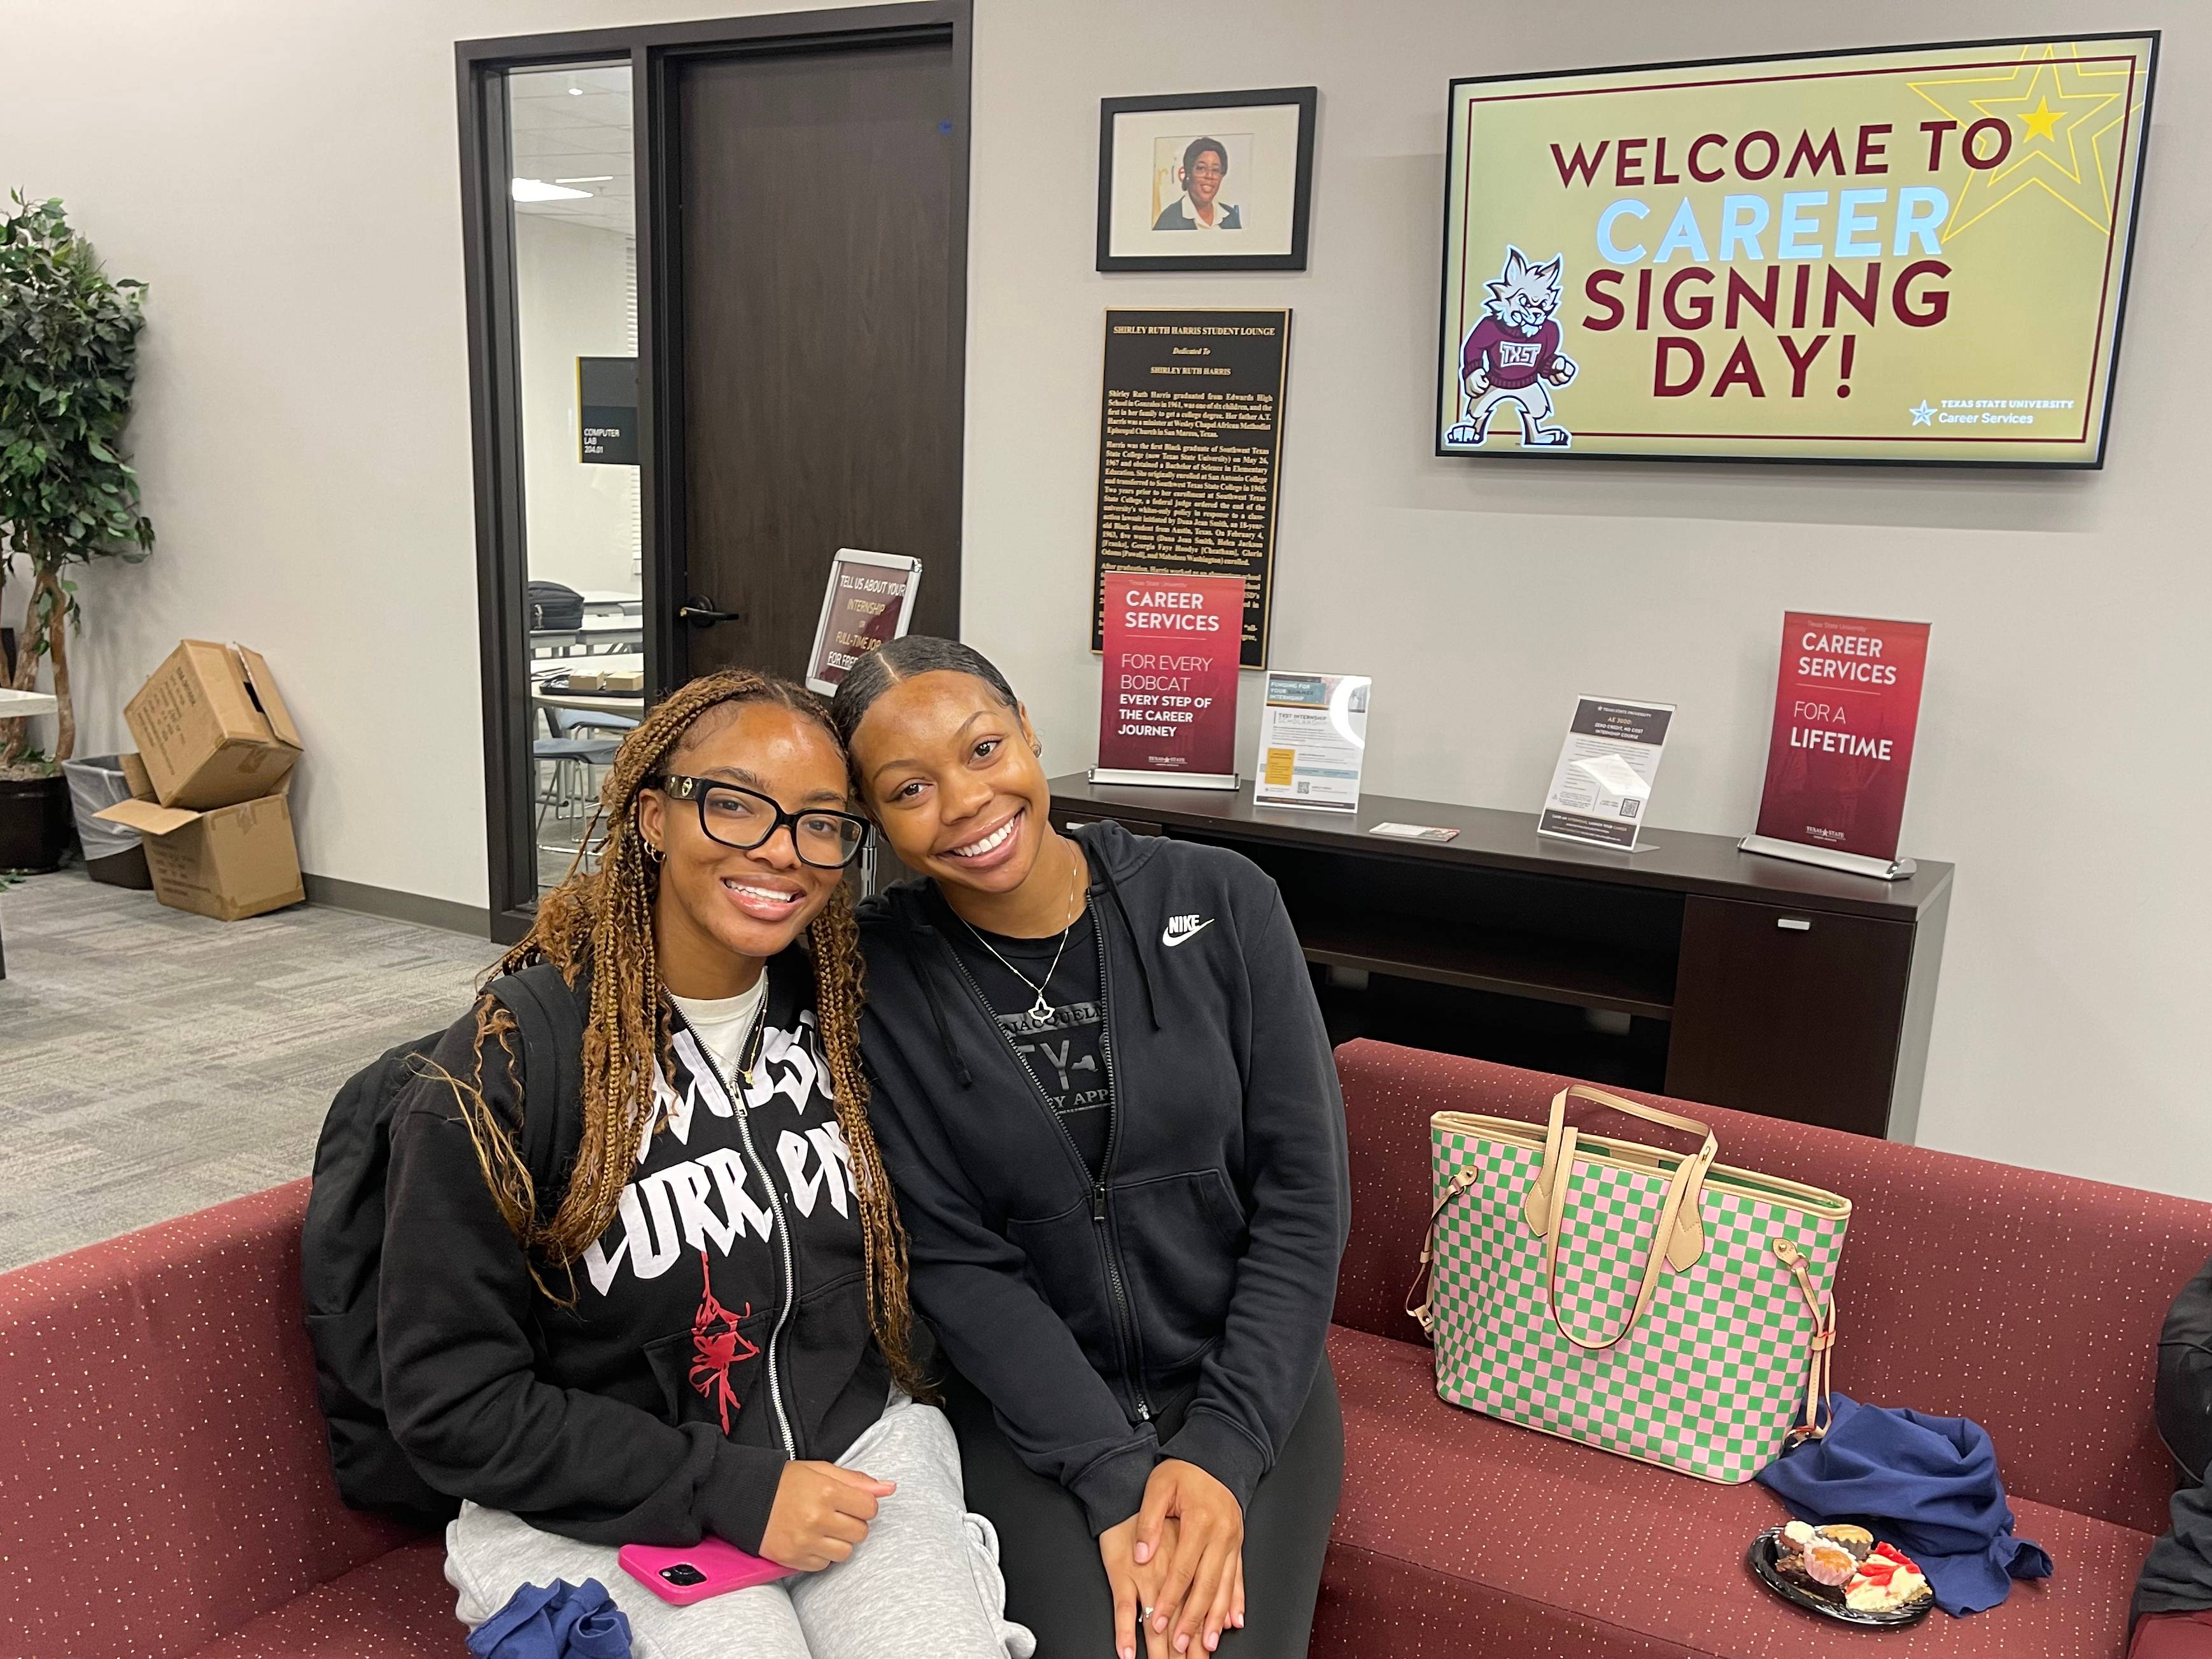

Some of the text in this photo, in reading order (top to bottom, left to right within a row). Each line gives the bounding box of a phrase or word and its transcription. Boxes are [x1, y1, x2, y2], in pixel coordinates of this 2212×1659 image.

[1550, 118, 2012, 188] WELCOME TO
[1597, 186, 1949, 264] CAREER
[1582, 260, 1952, 331] SIGNING
[1113, 326, 1148, 334] SHIRLEY
[1503, 344, 1540, 364] TXST
[1654, 335, 1856, 398] DAY!
[1939, 413, 2033, 424] Career Services
[584, 428, 619, 437] COMPUTER
[841, 575, 906, 596] TELL US ABOUT YOUR
[847, 598, 885, 616] INTERNSHIP
[1126, 590, 1204, 609] CAREER
[1125, 612, 1219, 631] SERVICES
[836, 632, 868, 649] FULL-TIME
[1802, 632, 1883, 658] CAREER
[828, 651, 842, 665] FOR
[1122, 654, 1213, 672] FOR EVERY
[1798, 656, 1896, 685] SERVICES
[1120, 674, 1191, 691] BOBCAT
[1120, 694, 1212, 708] EVERY STEP OF
[1119, 709, 1193, 723] THE CAREER
[1794, 701, 1846, 724] FOR A
[1118, 724, 1177, 737] JOURNEY
[1791, 727, 1892, 761] LIFETIME
[1169, 915, 1200, 933] NIKE
